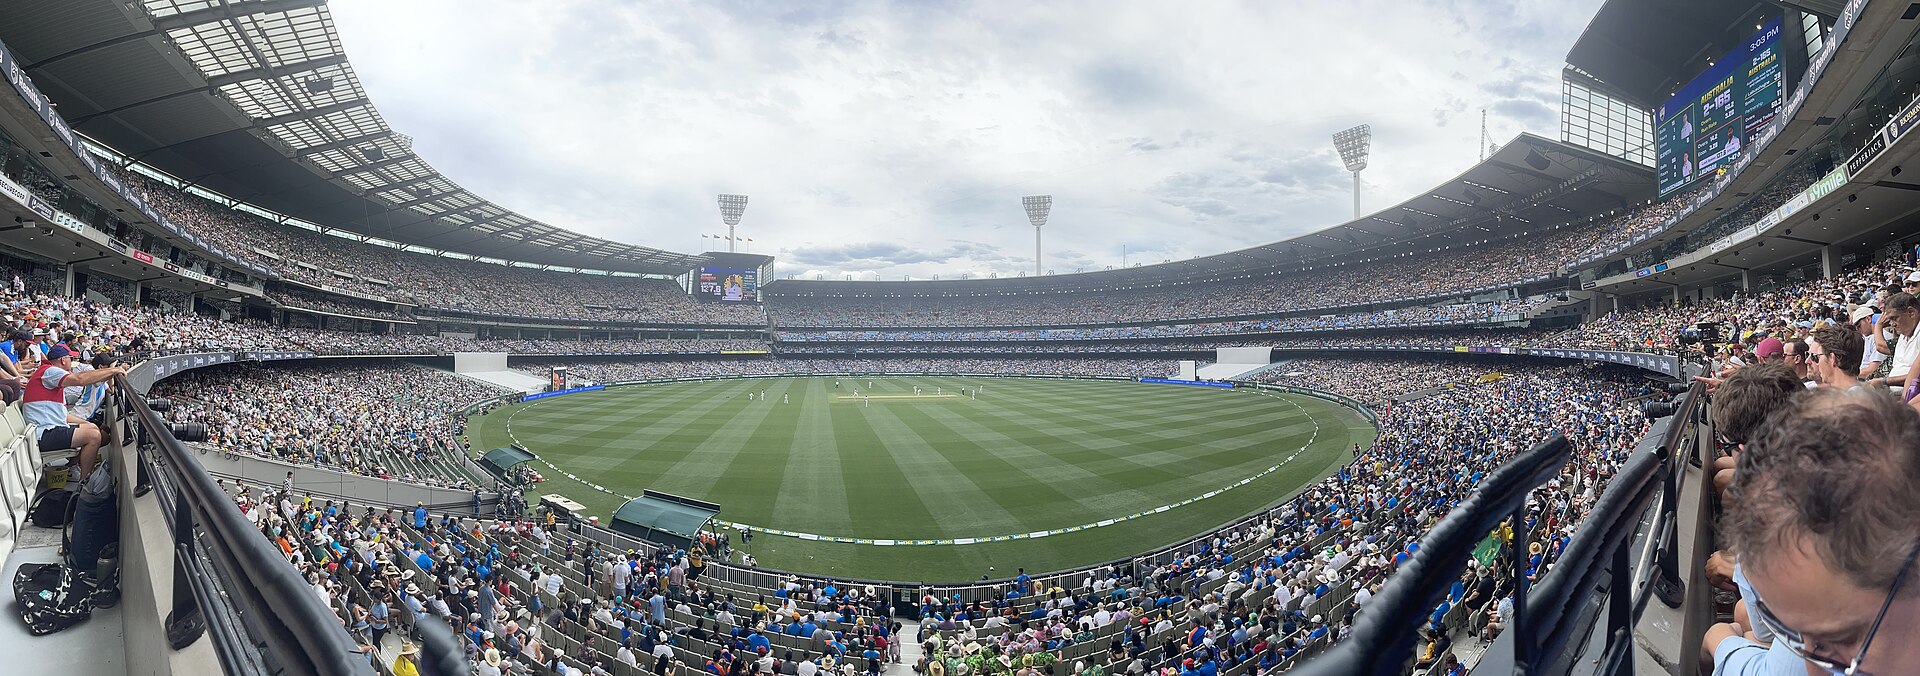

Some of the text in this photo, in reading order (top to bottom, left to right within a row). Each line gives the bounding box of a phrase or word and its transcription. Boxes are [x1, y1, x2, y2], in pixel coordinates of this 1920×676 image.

[1750, 25, 1779, 51] 3:03 PM
[1816, 32, 1836, 73] Remitly
[1748, 53, 1777, 77] AUSTRALIA
[19, 74, 42, 111] Remitly
[1701, 75, 1734, 105] AUSTRALIA
[1703, 88, 1731, 118] 2-165
[1788, 86, 1804, 116] Remitly
[55, 116, 73, 146] Remitly
[1760, 124, 1777, 147] Remitly
[1850, 139, 1882, 172] PEPPERJACK
